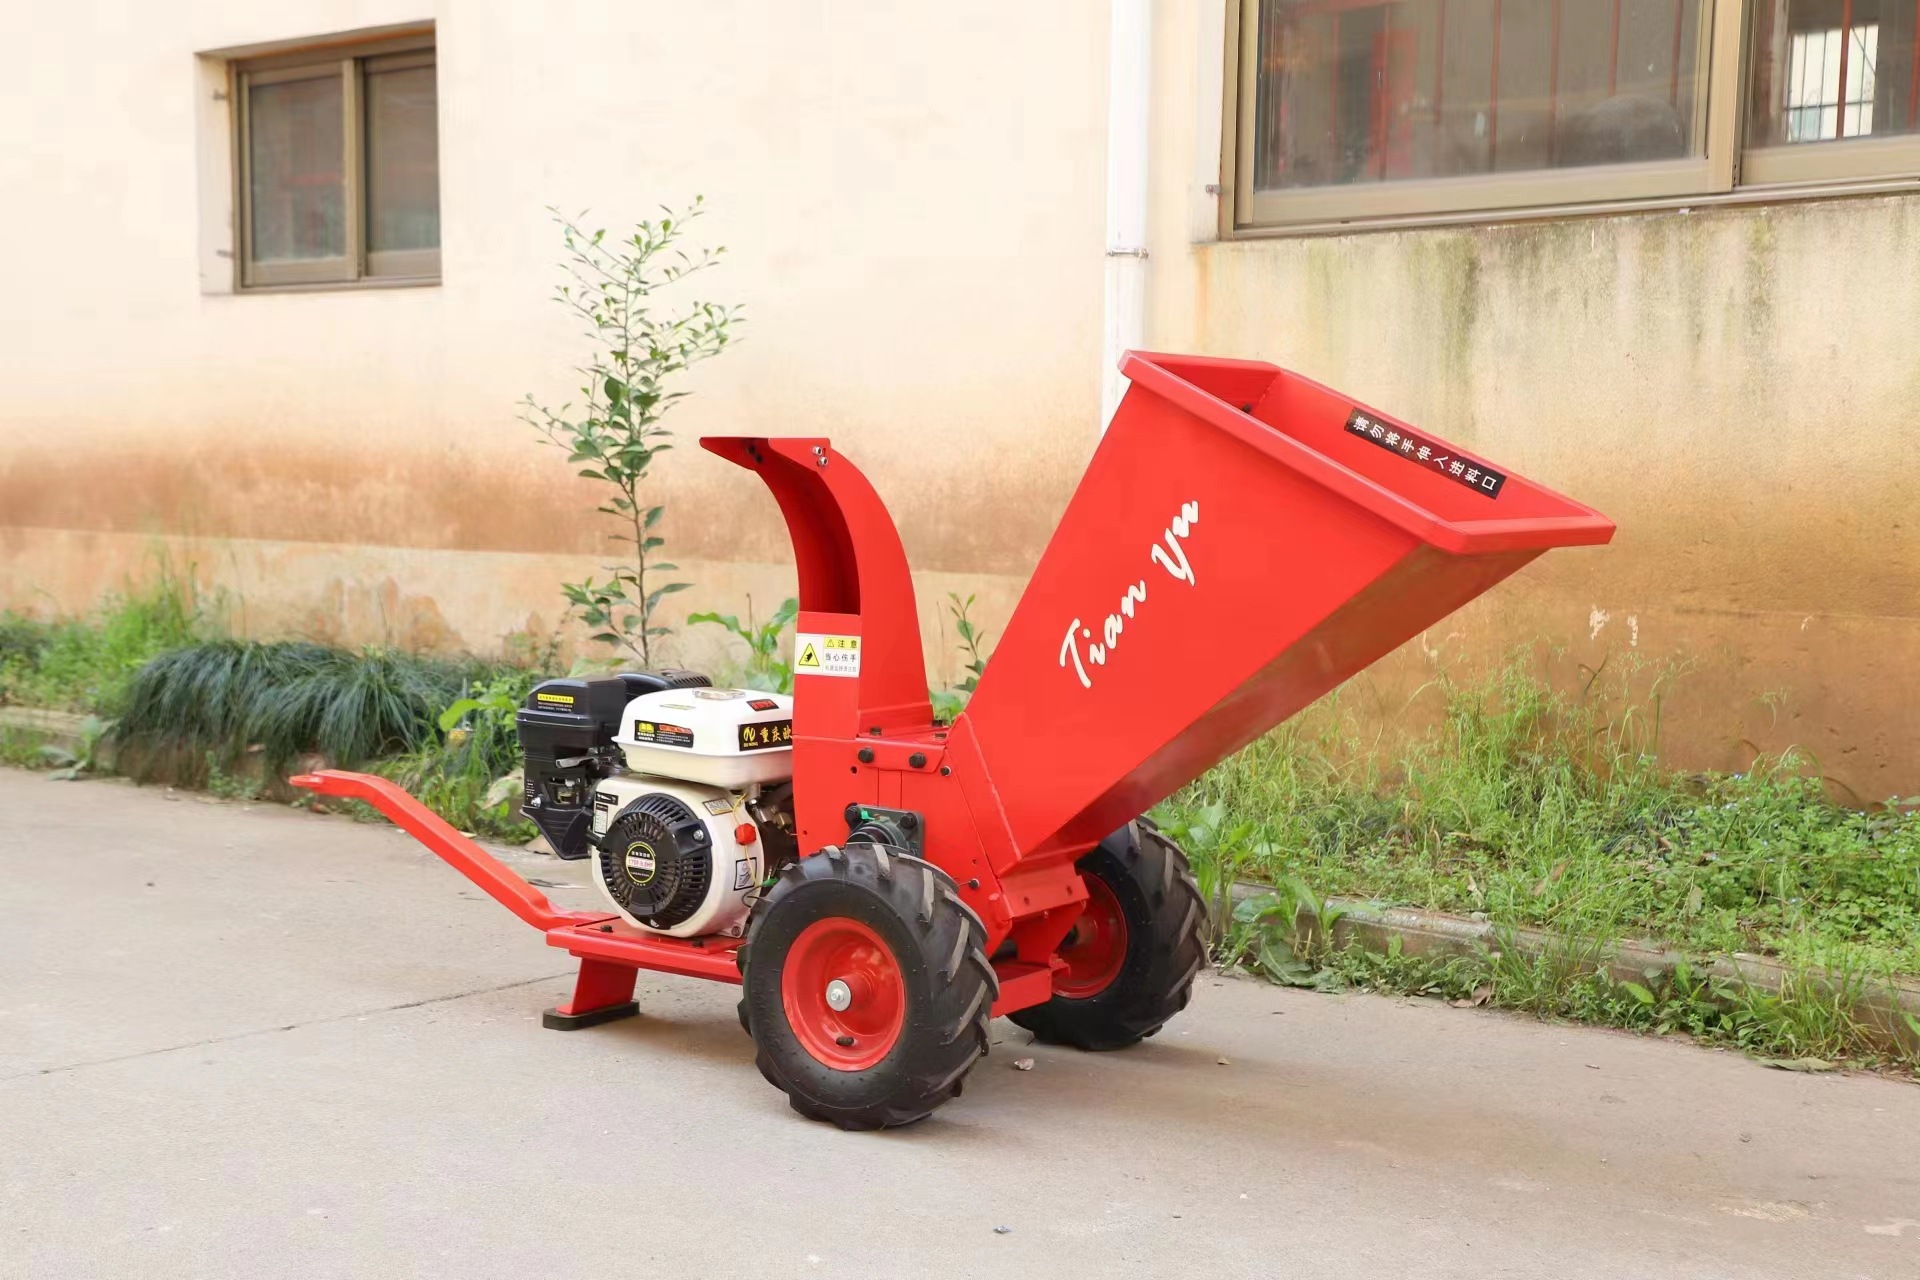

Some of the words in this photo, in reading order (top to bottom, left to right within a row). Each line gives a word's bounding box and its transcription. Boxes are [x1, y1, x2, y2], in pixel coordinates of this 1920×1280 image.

[1353, 415, 1497, 491] 请勿将手伸入进料口
[837, 639, 857, 649] 注意
[1059, 579, 1147, 689] Tian
[825, 653, 857, 663] 当心伤手
